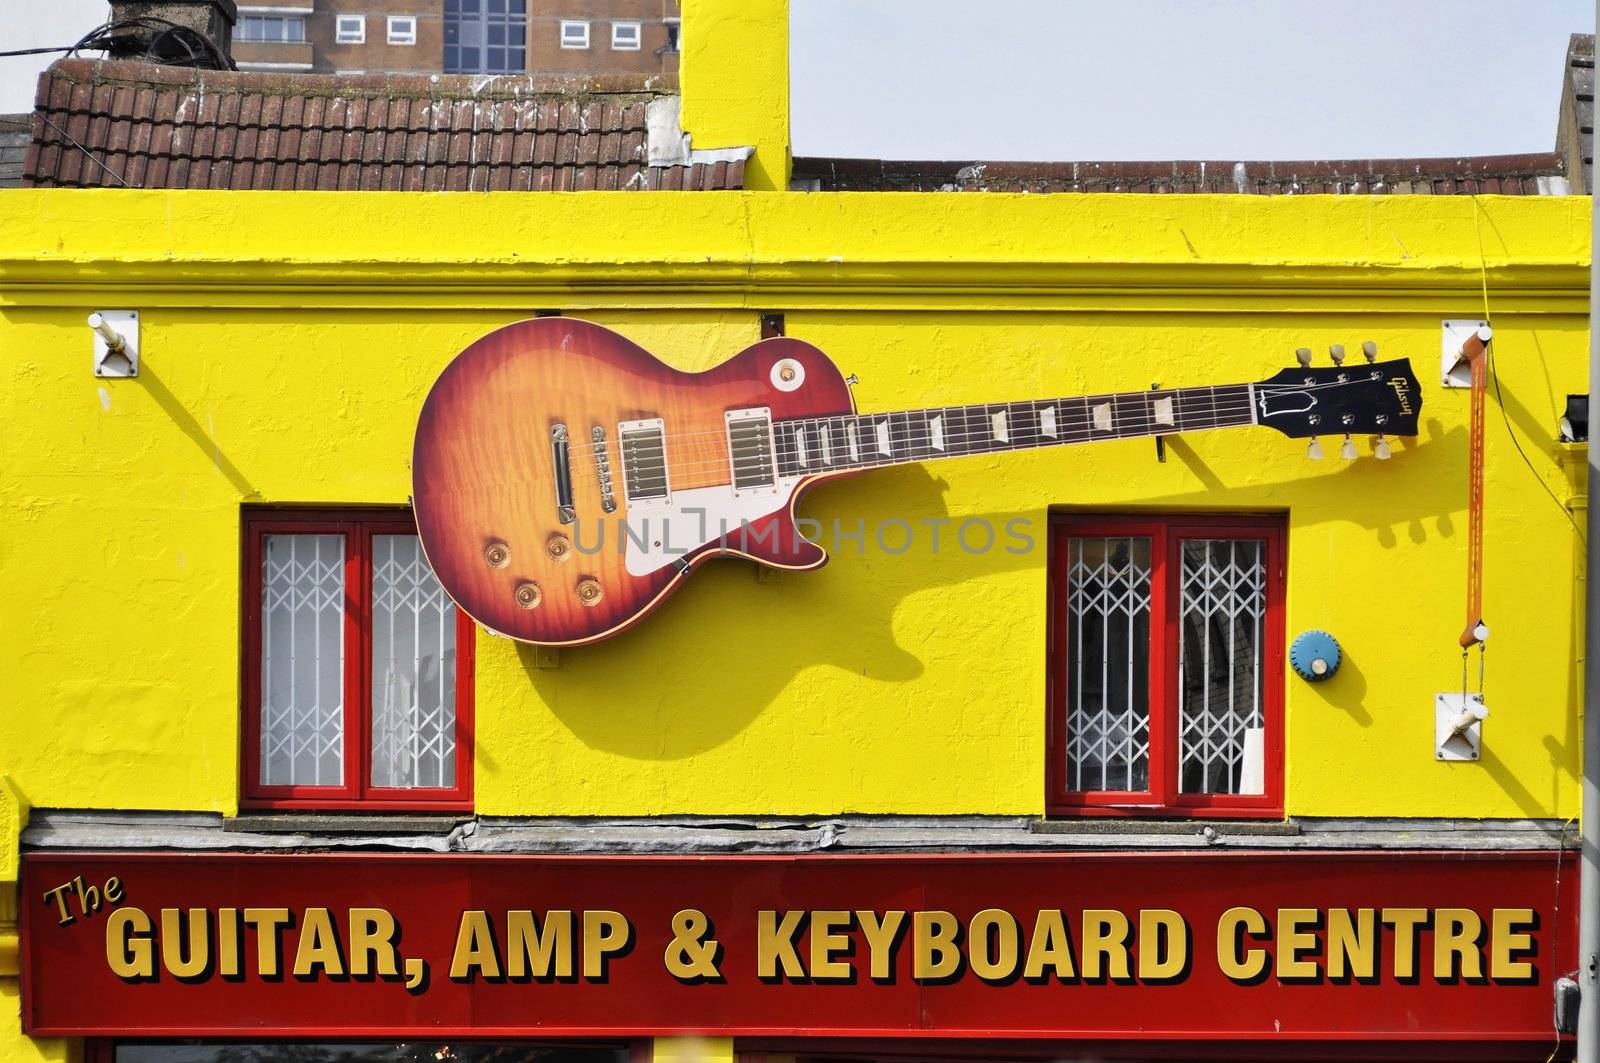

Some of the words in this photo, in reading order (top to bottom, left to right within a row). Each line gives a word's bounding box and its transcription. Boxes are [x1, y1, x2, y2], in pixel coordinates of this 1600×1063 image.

[43, 876, 122, 923] The
[106, 907, 422, 988] GUITAR,
[450, 910, 628, 977] AMP
[665, 909, 719, 978] &
[758, 909, 1186, 979] KEYBOARD
[1217, 907, 1532, 979] CENTRE
